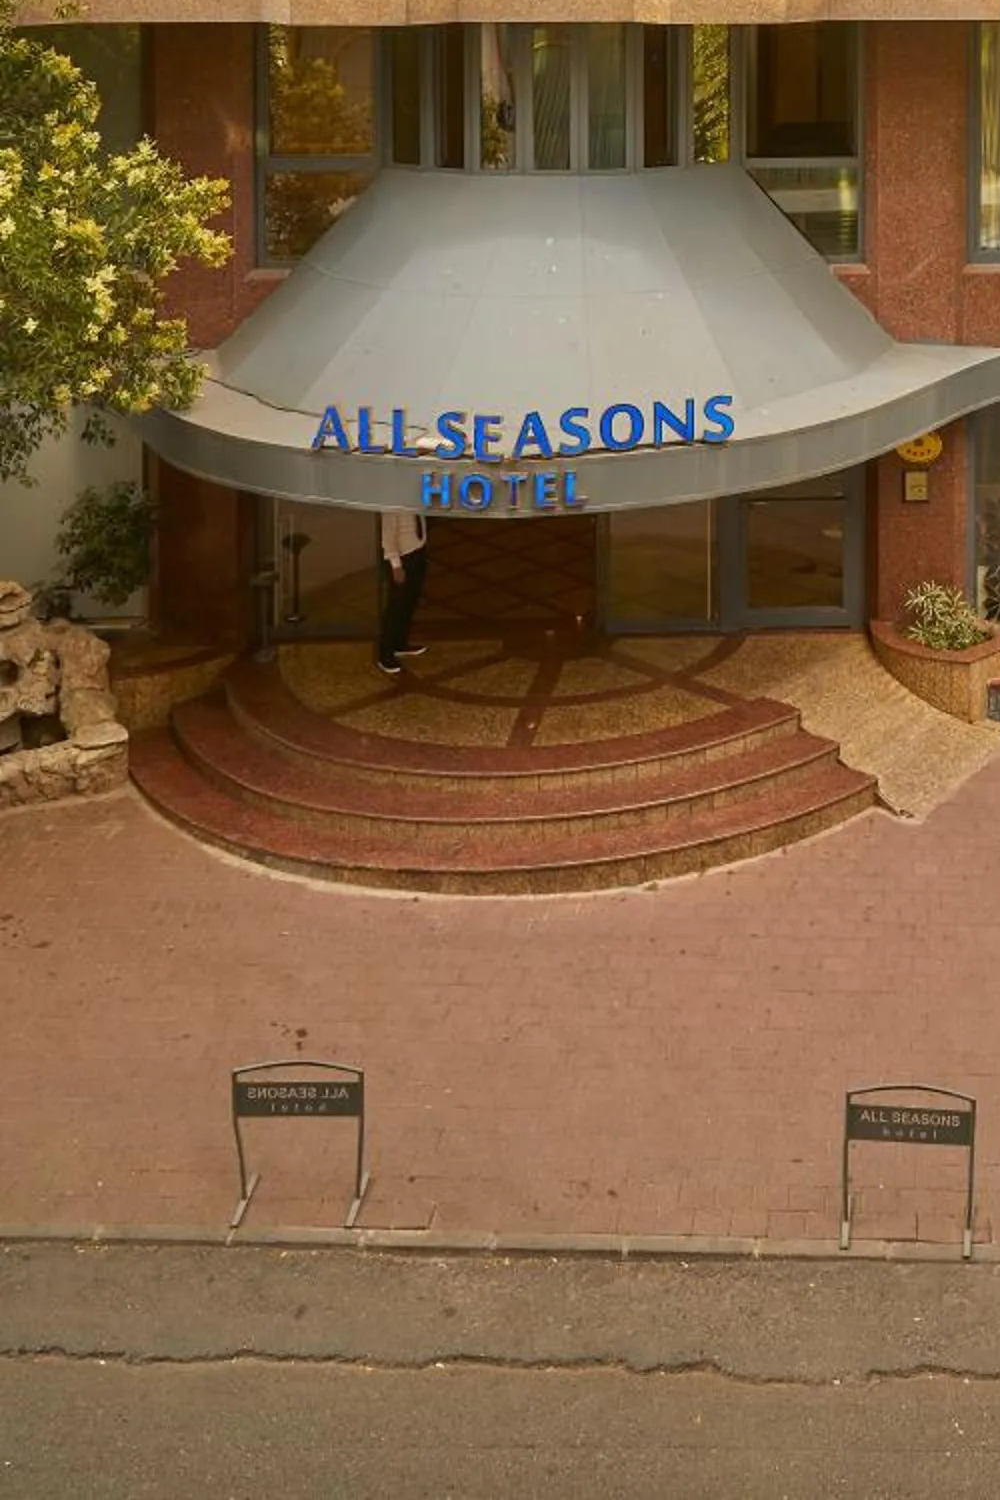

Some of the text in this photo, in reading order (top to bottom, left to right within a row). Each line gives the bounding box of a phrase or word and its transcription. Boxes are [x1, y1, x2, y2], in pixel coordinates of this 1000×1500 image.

[311, 395, 735, 462] ALL SEASONS
[419, 471, 588, 511] HOTEL
[860, 1109, 961, 1127] ALL SEASONS
